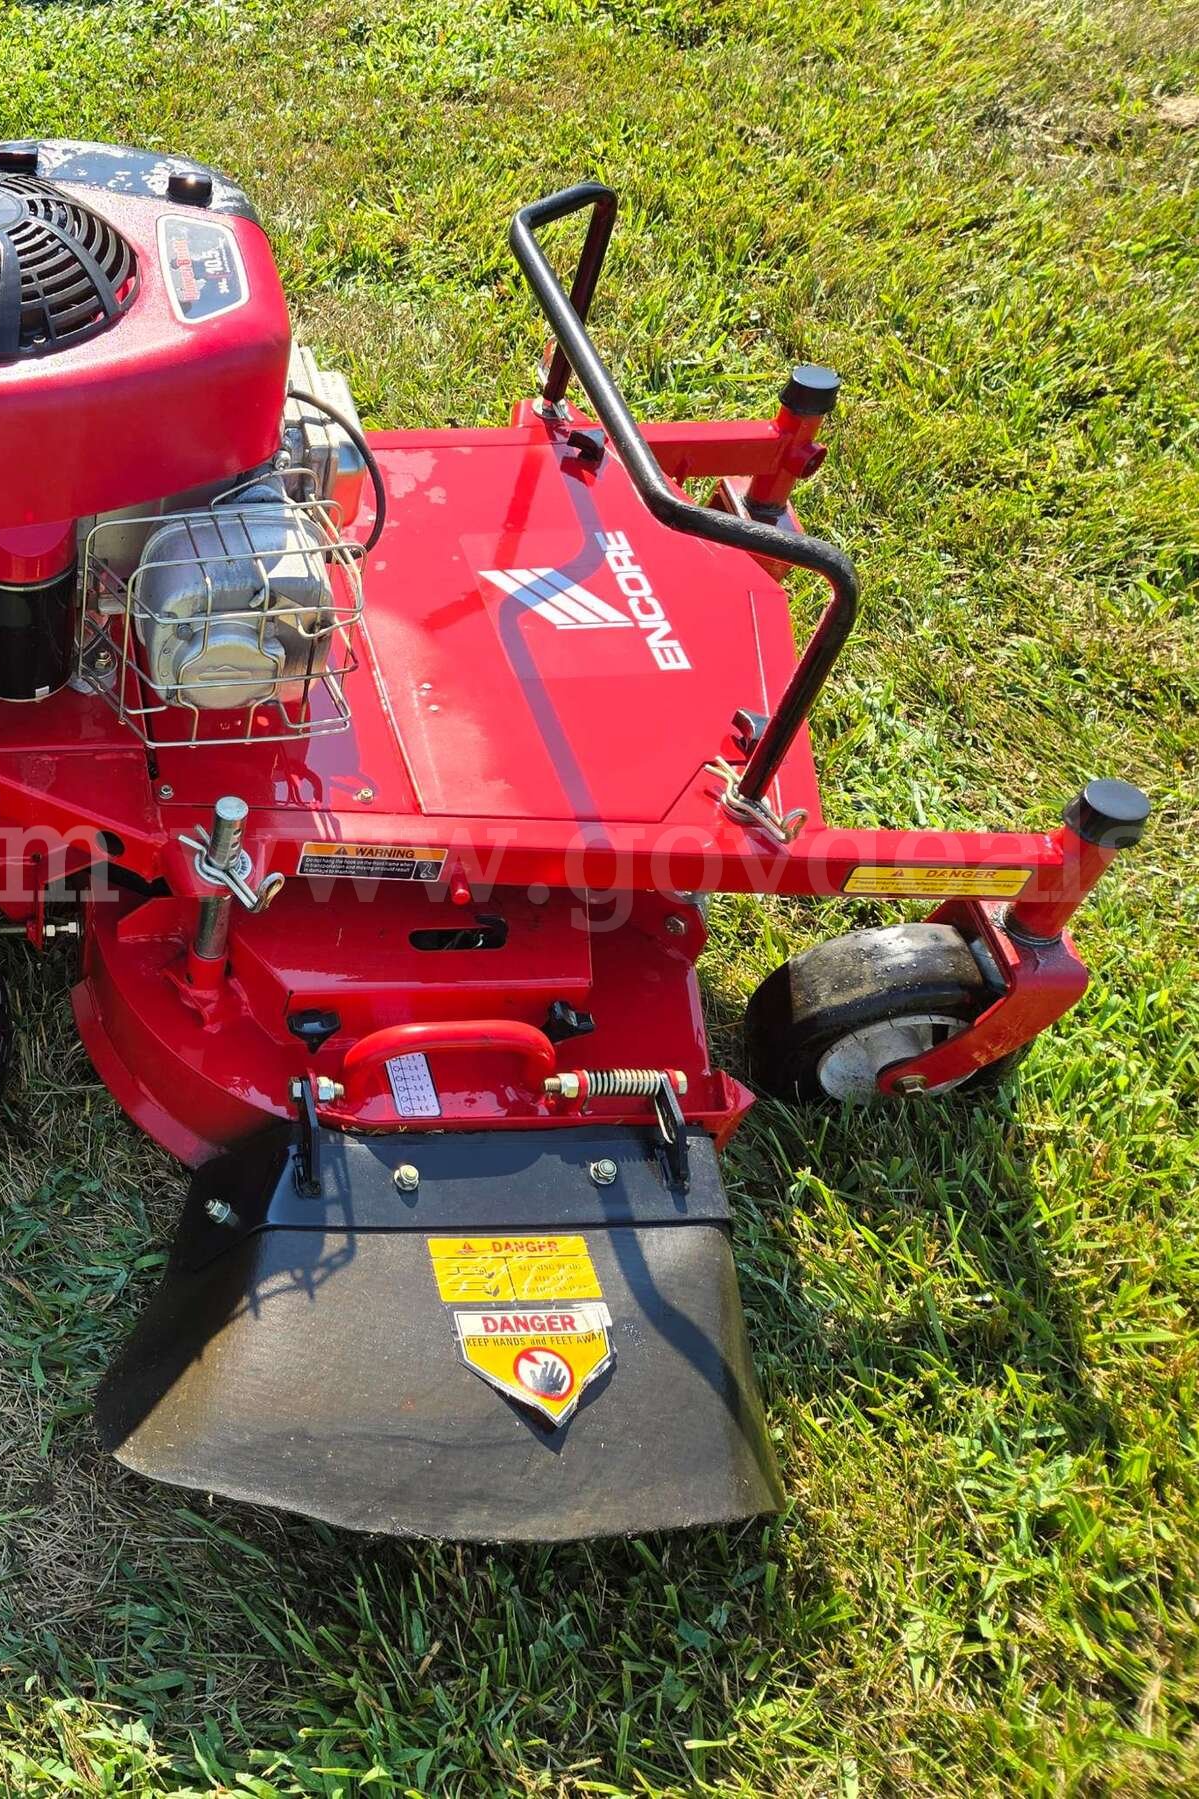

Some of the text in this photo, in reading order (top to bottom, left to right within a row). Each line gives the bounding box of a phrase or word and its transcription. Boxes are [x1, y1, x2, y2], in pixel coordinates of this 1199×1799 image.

[595, 530, 692, 670] ENCORE
[355, 847, 415, 859] WARNING
[926, 870, 997, 879] DANGER
[491, 1241, 559, 1253] DANGER
[481, 1314, 577, 1333] DANGER
[466, 1331, 603, 1348] KEEP HANDS and FEET AWAY
